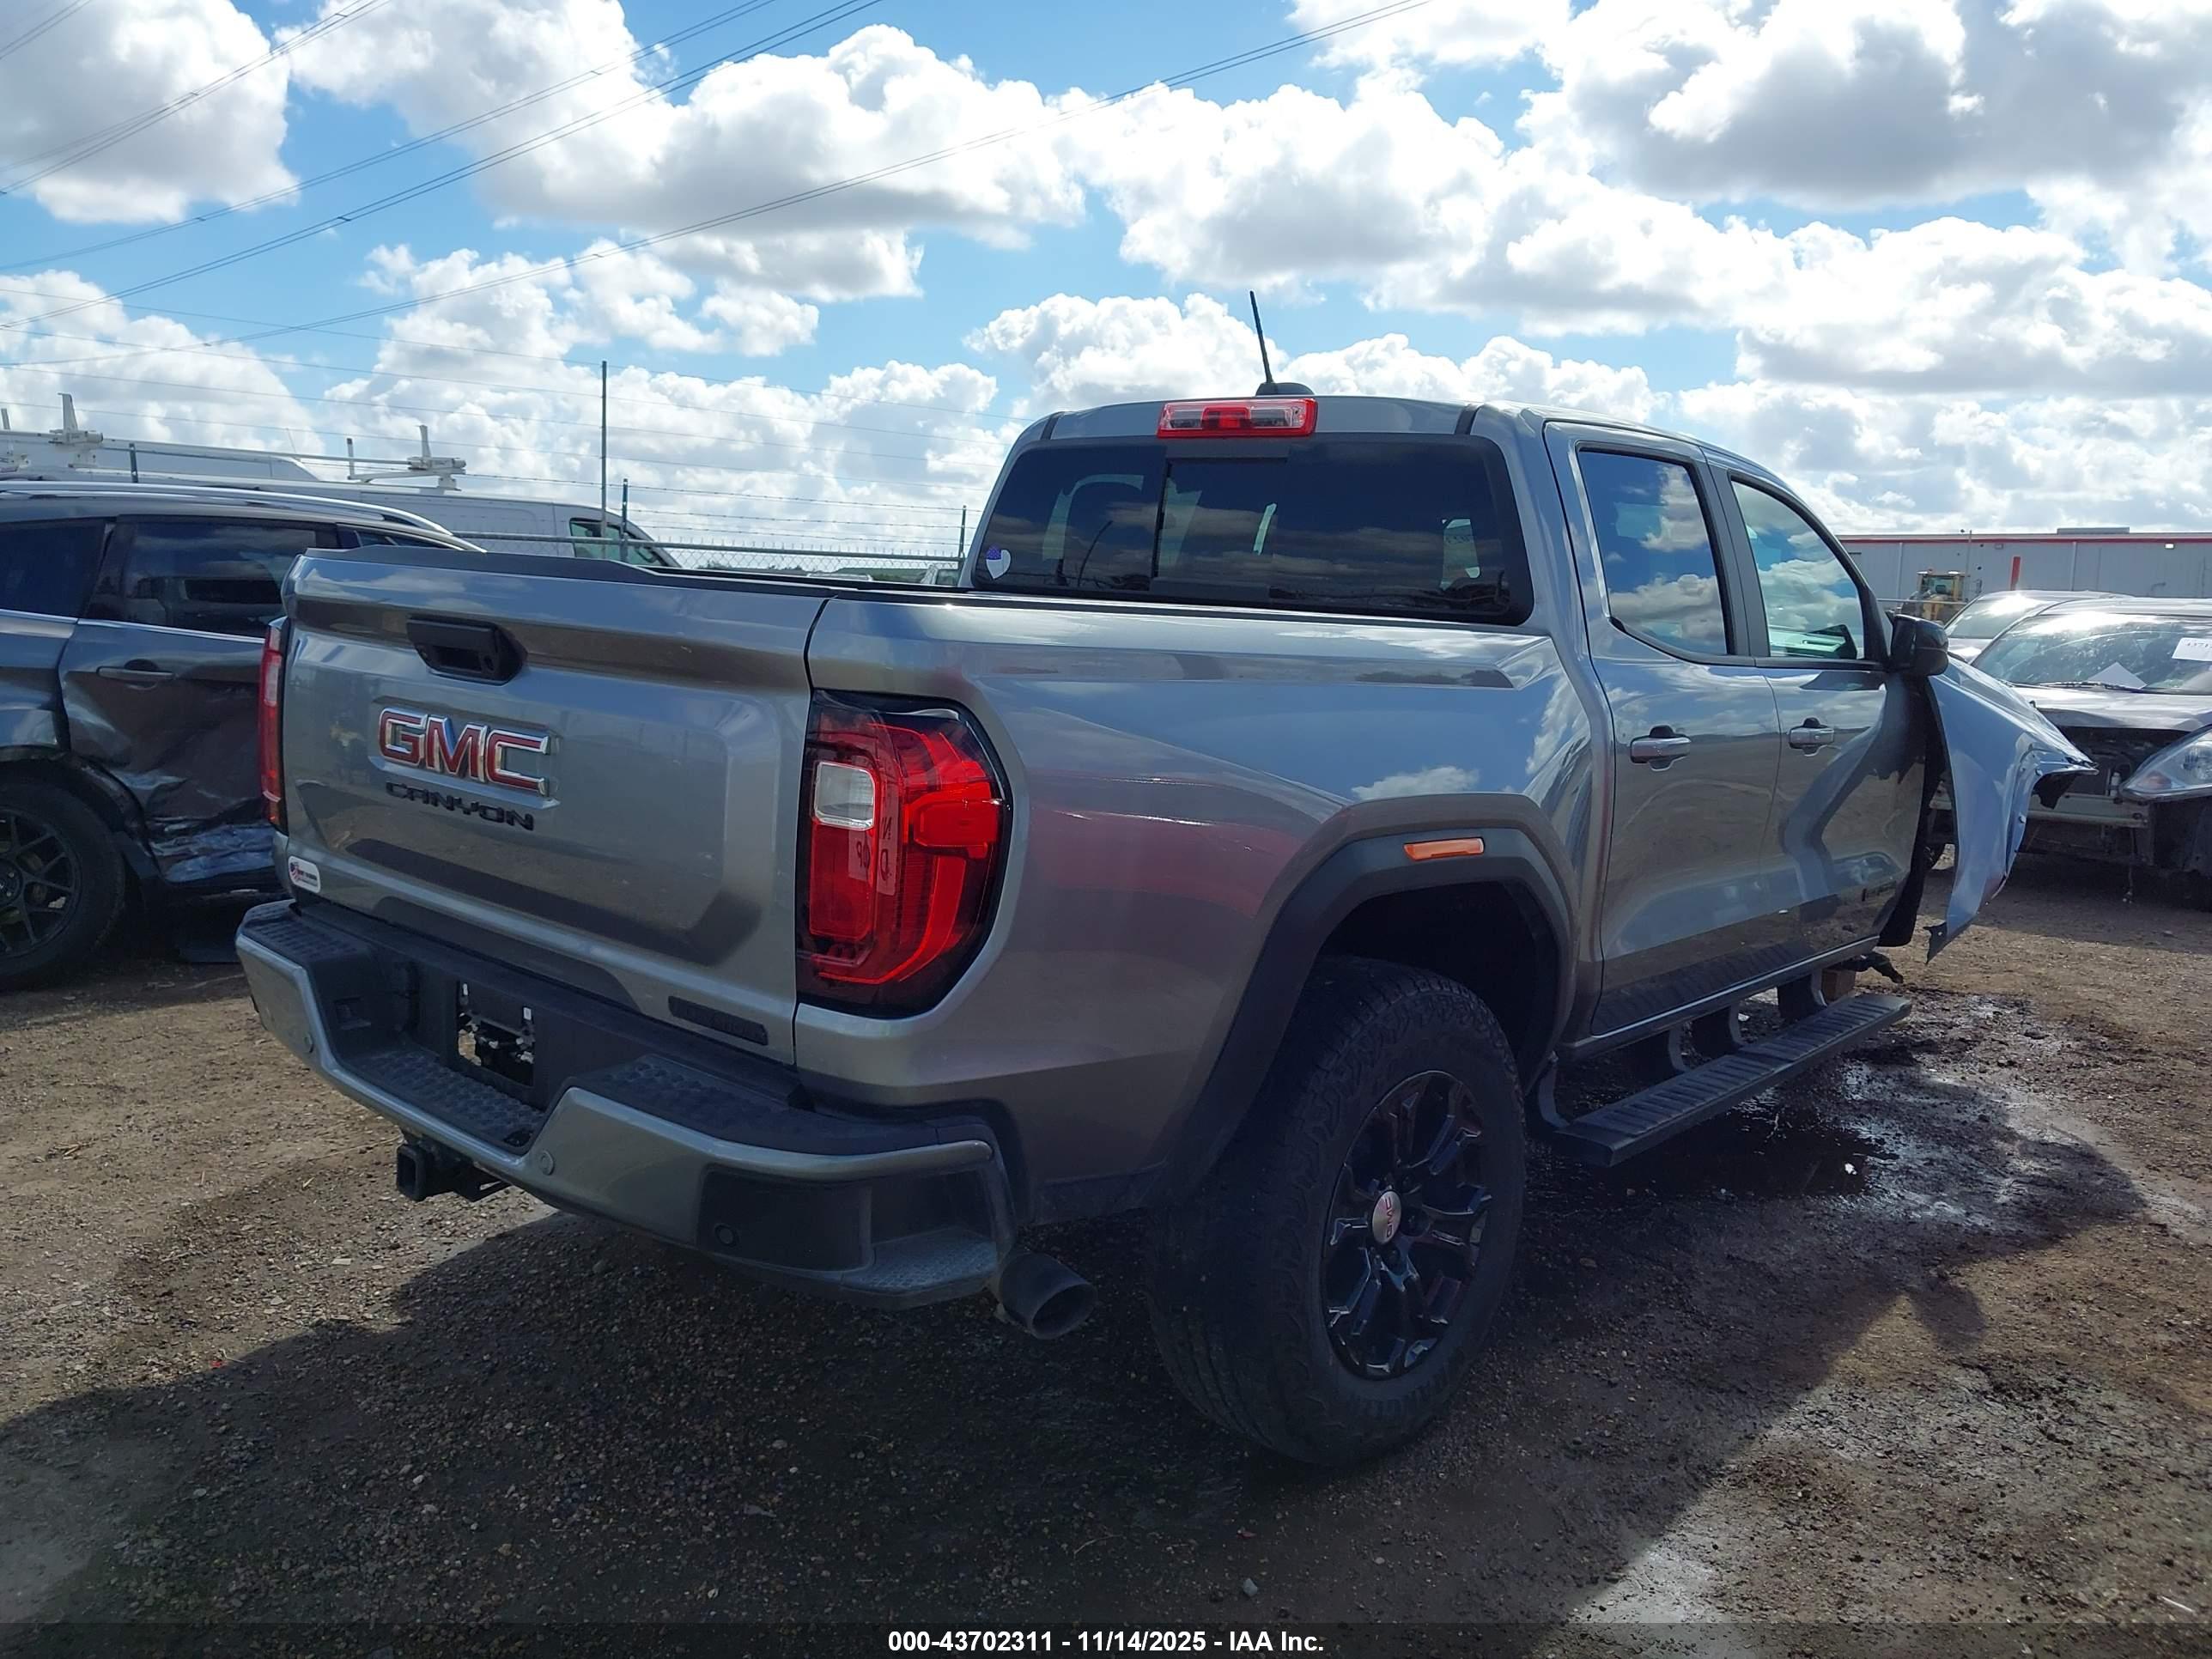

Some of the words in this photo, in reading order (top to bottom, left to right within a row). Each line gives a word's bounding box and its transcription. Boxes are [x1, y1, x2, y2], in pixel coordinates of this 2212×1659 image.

[379, 707, 550, 797] GMC
[386, 781, 534, 830] CANYON
[1384, 1196, 1395, 1238] GMC
